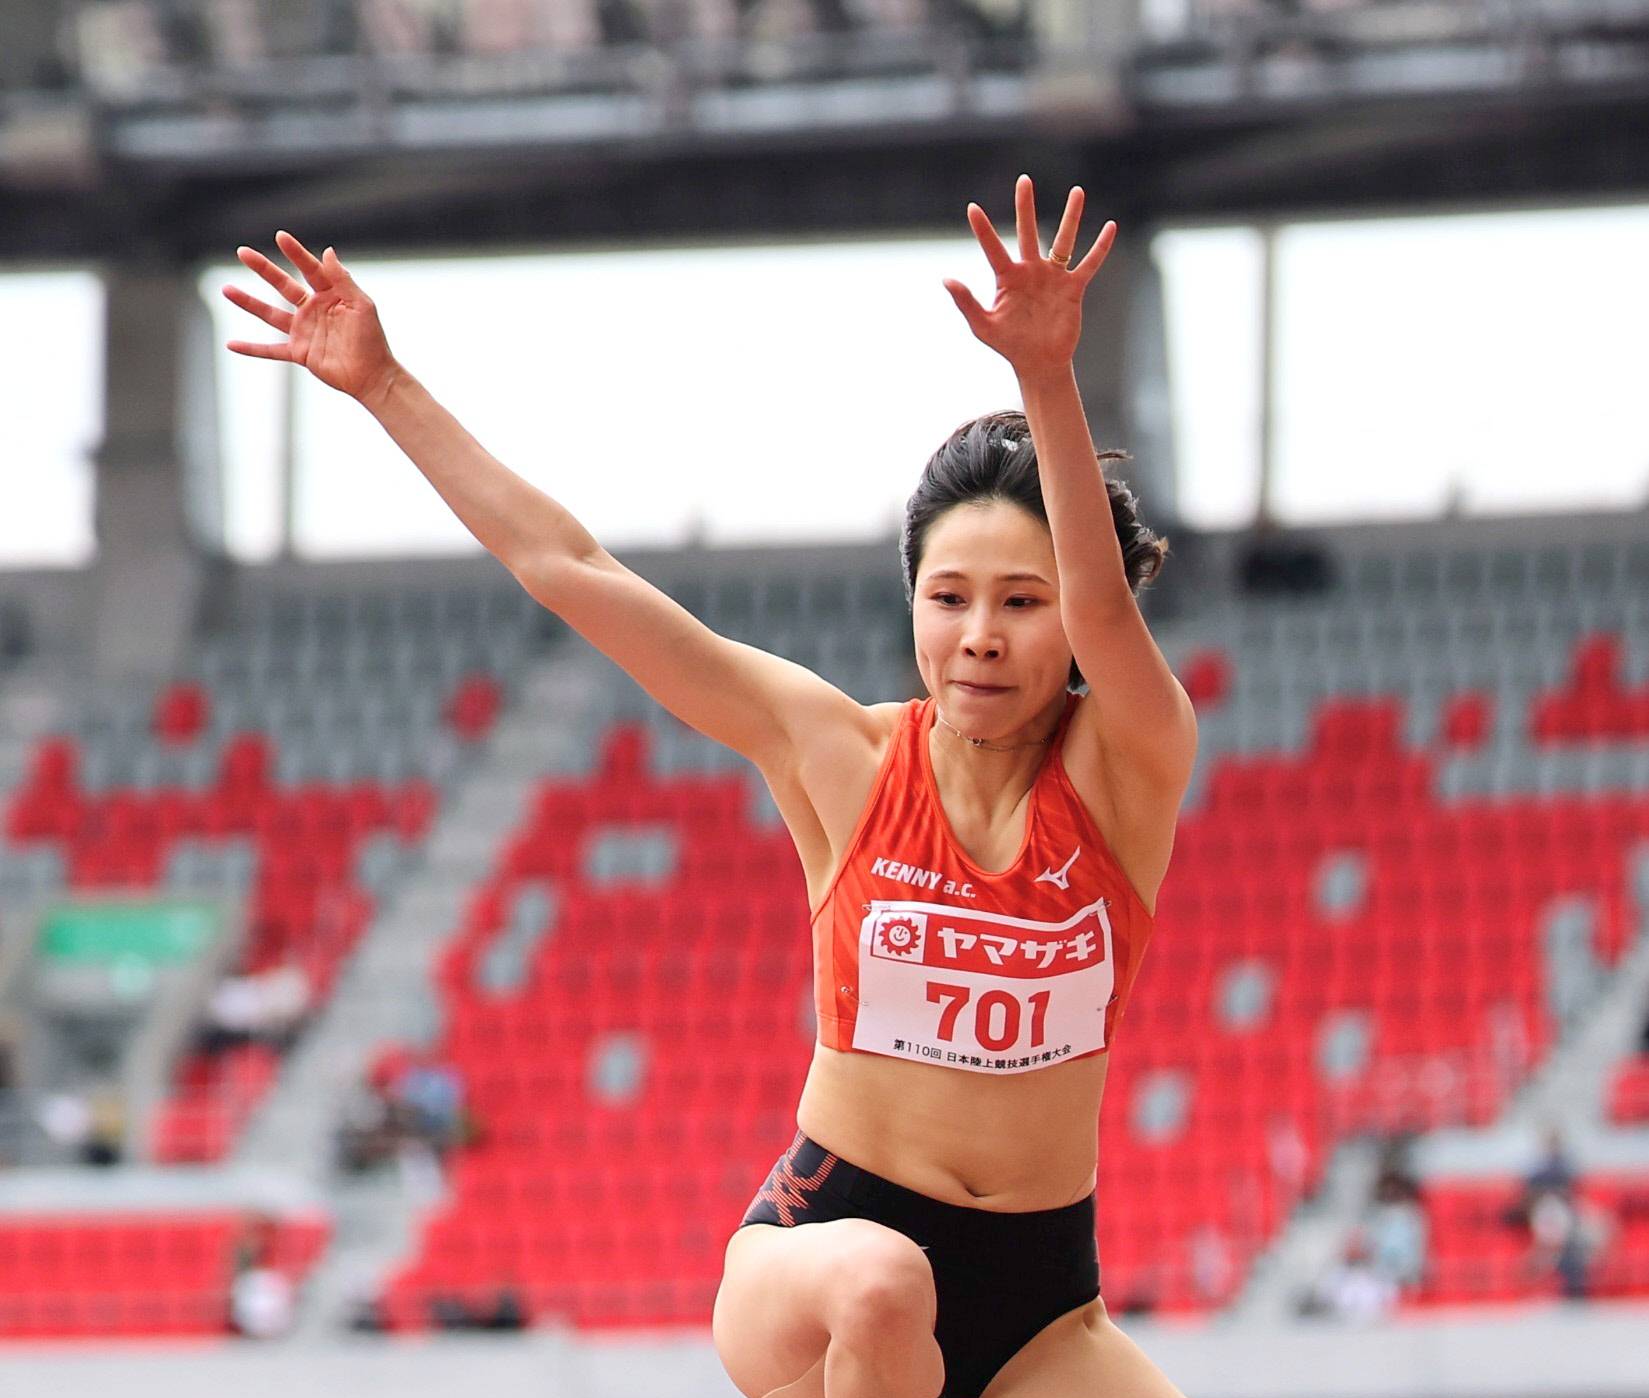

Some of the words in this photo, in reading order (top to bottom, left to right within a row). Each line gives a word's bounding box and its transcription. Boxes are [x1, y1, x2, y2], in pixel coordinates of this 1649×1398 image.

[871, 857, 942, 889] KENNY
[943, 880, 976, 898] a.c.
[938, 927, 1096, 968] ヤマザキ
[926, 982, 1051, 1052] 701
[893, 1038, 942, 1061] 第110回
